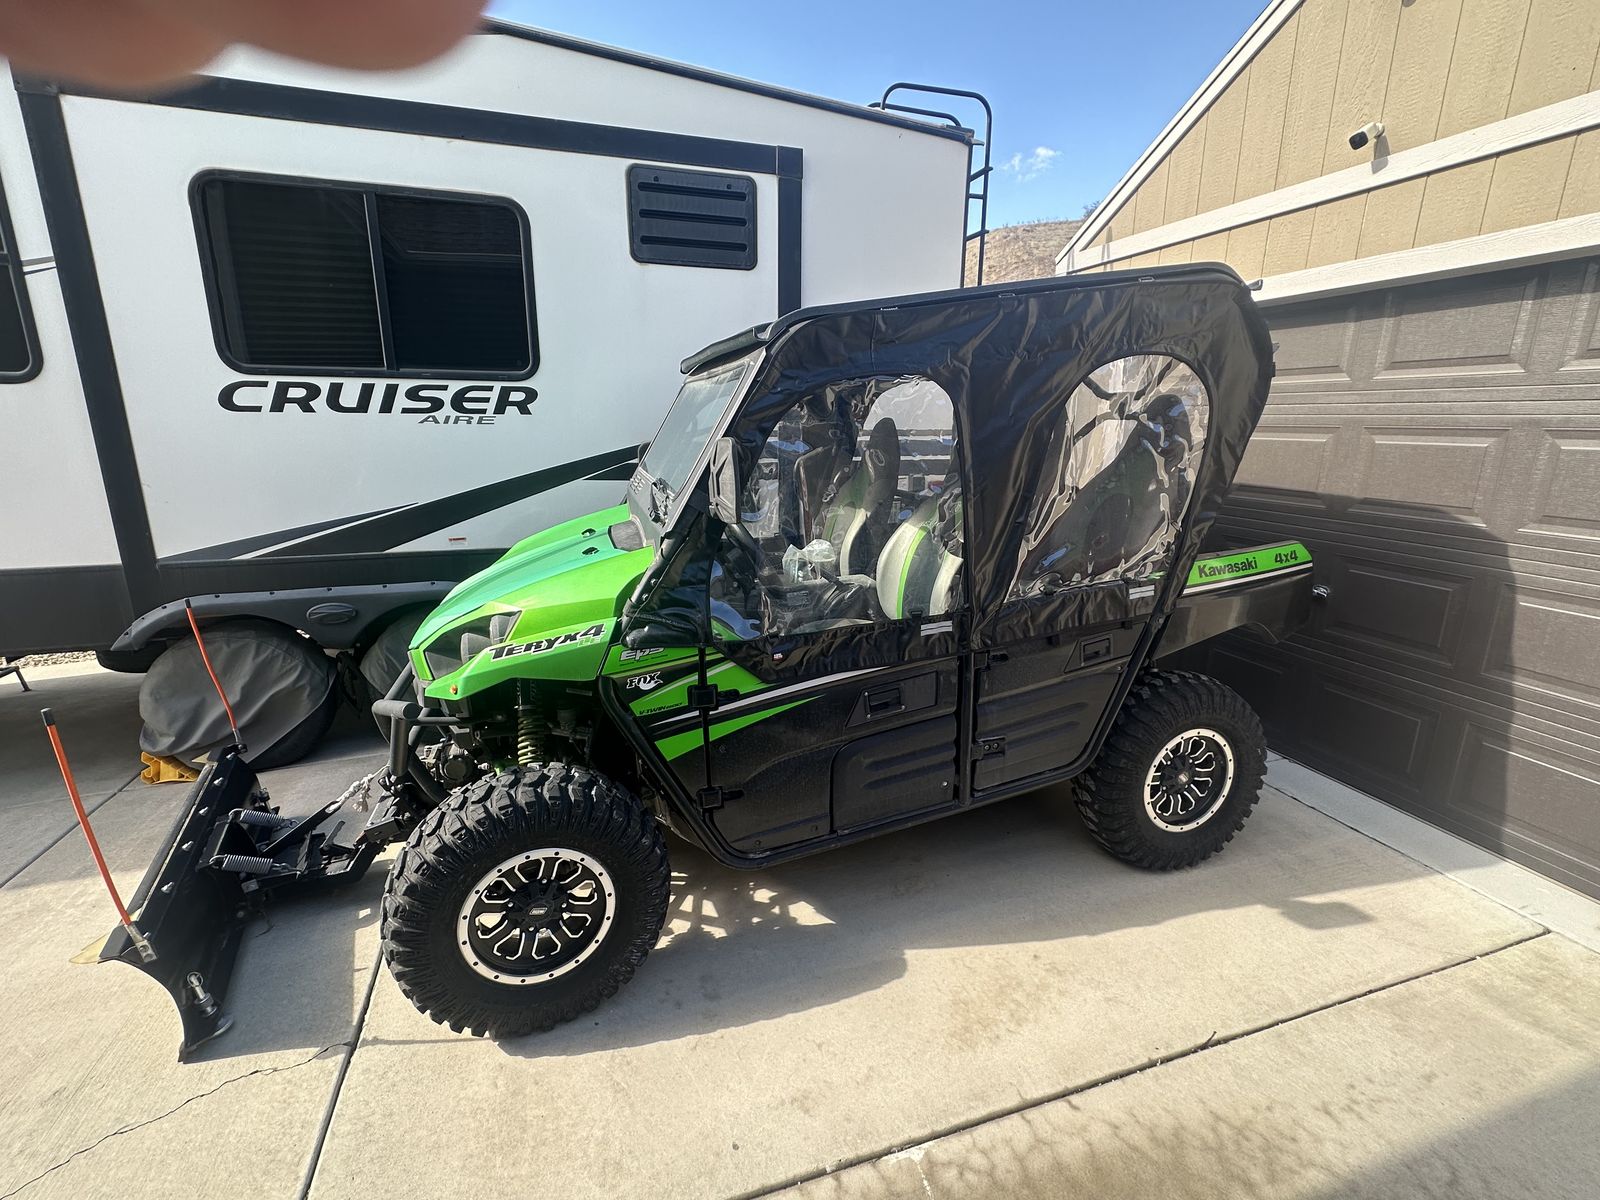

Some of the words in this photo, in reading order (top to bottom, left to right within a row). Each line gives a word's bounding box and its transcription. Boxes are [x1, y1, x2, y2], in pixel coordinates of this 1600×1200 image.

[217, 380, 539, 415] CRUISER
[418, 415, 497, 425] AIRE
[1197, 556, 1258, 578] Kawasaki
[1274, 549, 1299, 564] 4x4
[488, 622, 606, 661] TERYX4
[626, 671, 663, 690] FOX
